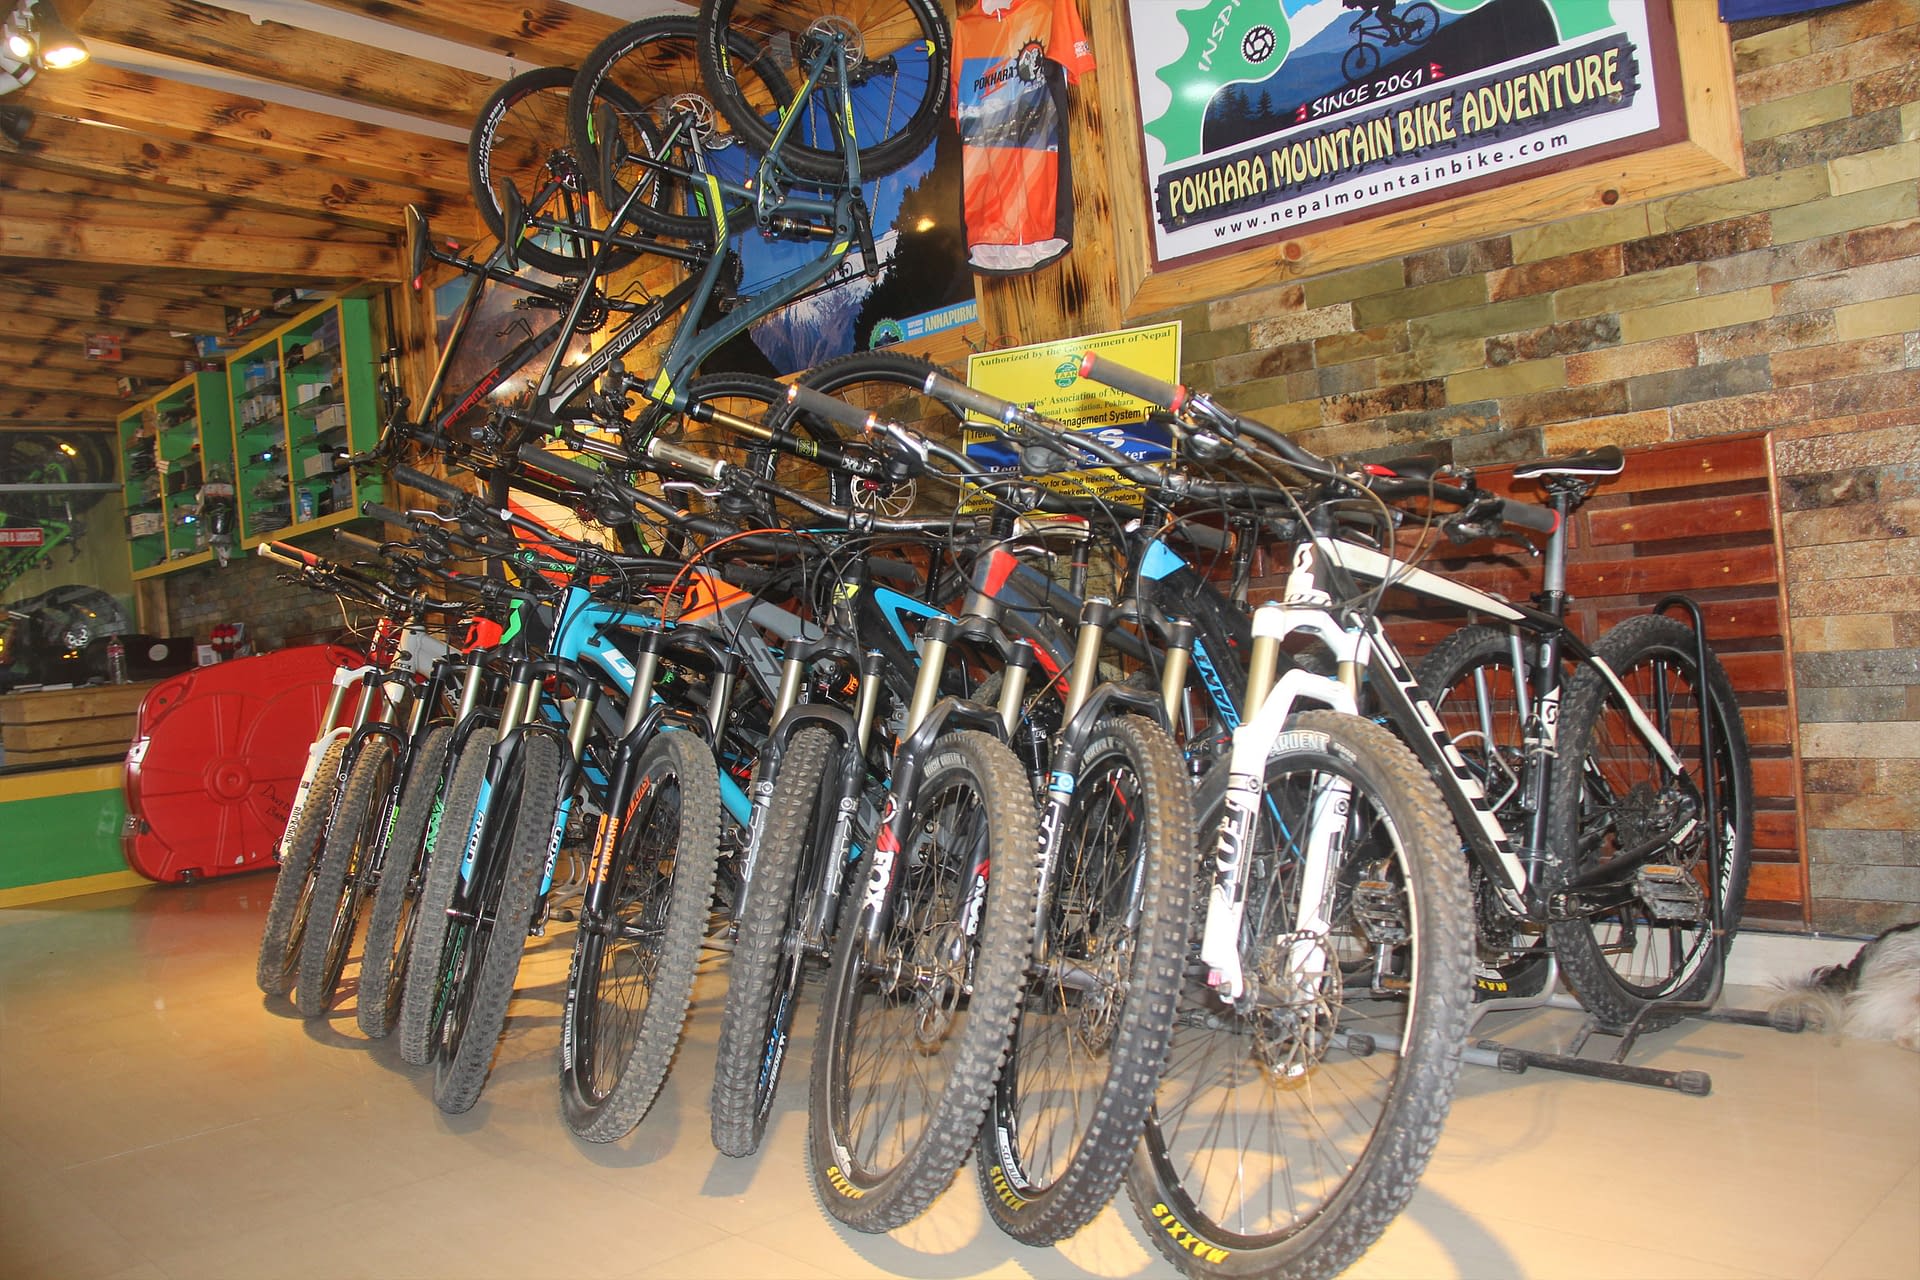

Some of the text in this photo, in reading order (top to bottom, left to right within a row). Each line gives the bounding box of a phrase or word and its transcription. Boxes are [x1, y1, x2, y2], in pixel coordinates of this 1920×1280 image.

[974, 66, 1014, 92] POKHARA
[1312, 68, 1423, 117] SINCE 2061
[1169, 47, 1623, 218] POKHARA MOUNTAIN BIKE ADVENTURE
[1214, 131, 1568, 238] www.nepalmountainbike.com
[924, 304, 977, 332] ANNAPURNA
[575, 302, 664, 387] FORMAT
[978, 352, 1029, 367] Authorized
[1033, 351, 1044, 359] by
[1064, 338, 1125, 353] Government
[1128, 335, 1138, 343] of
[1141, 329, 1171, 342] Nepal
[1051, 391, 1097, 405] Association
[1099, 389, 1109, 398] of
[1110, 387, 1127, 398] Nep
[1105, 399, 1134, 409] Pokhara
[1109, 409, 1141, 424] System
[1269, 729, 1331, 758] ARDENT
[598, 817, 619, 882] RHYTHM 34
[862, 849, 895, 913] FOX
[826, 1165, 865, 1200] MAXXIS
[990, 1165, 1027, 1211] MAXXIS
[1151, 1203, 1229, 1265] MAXXIS
